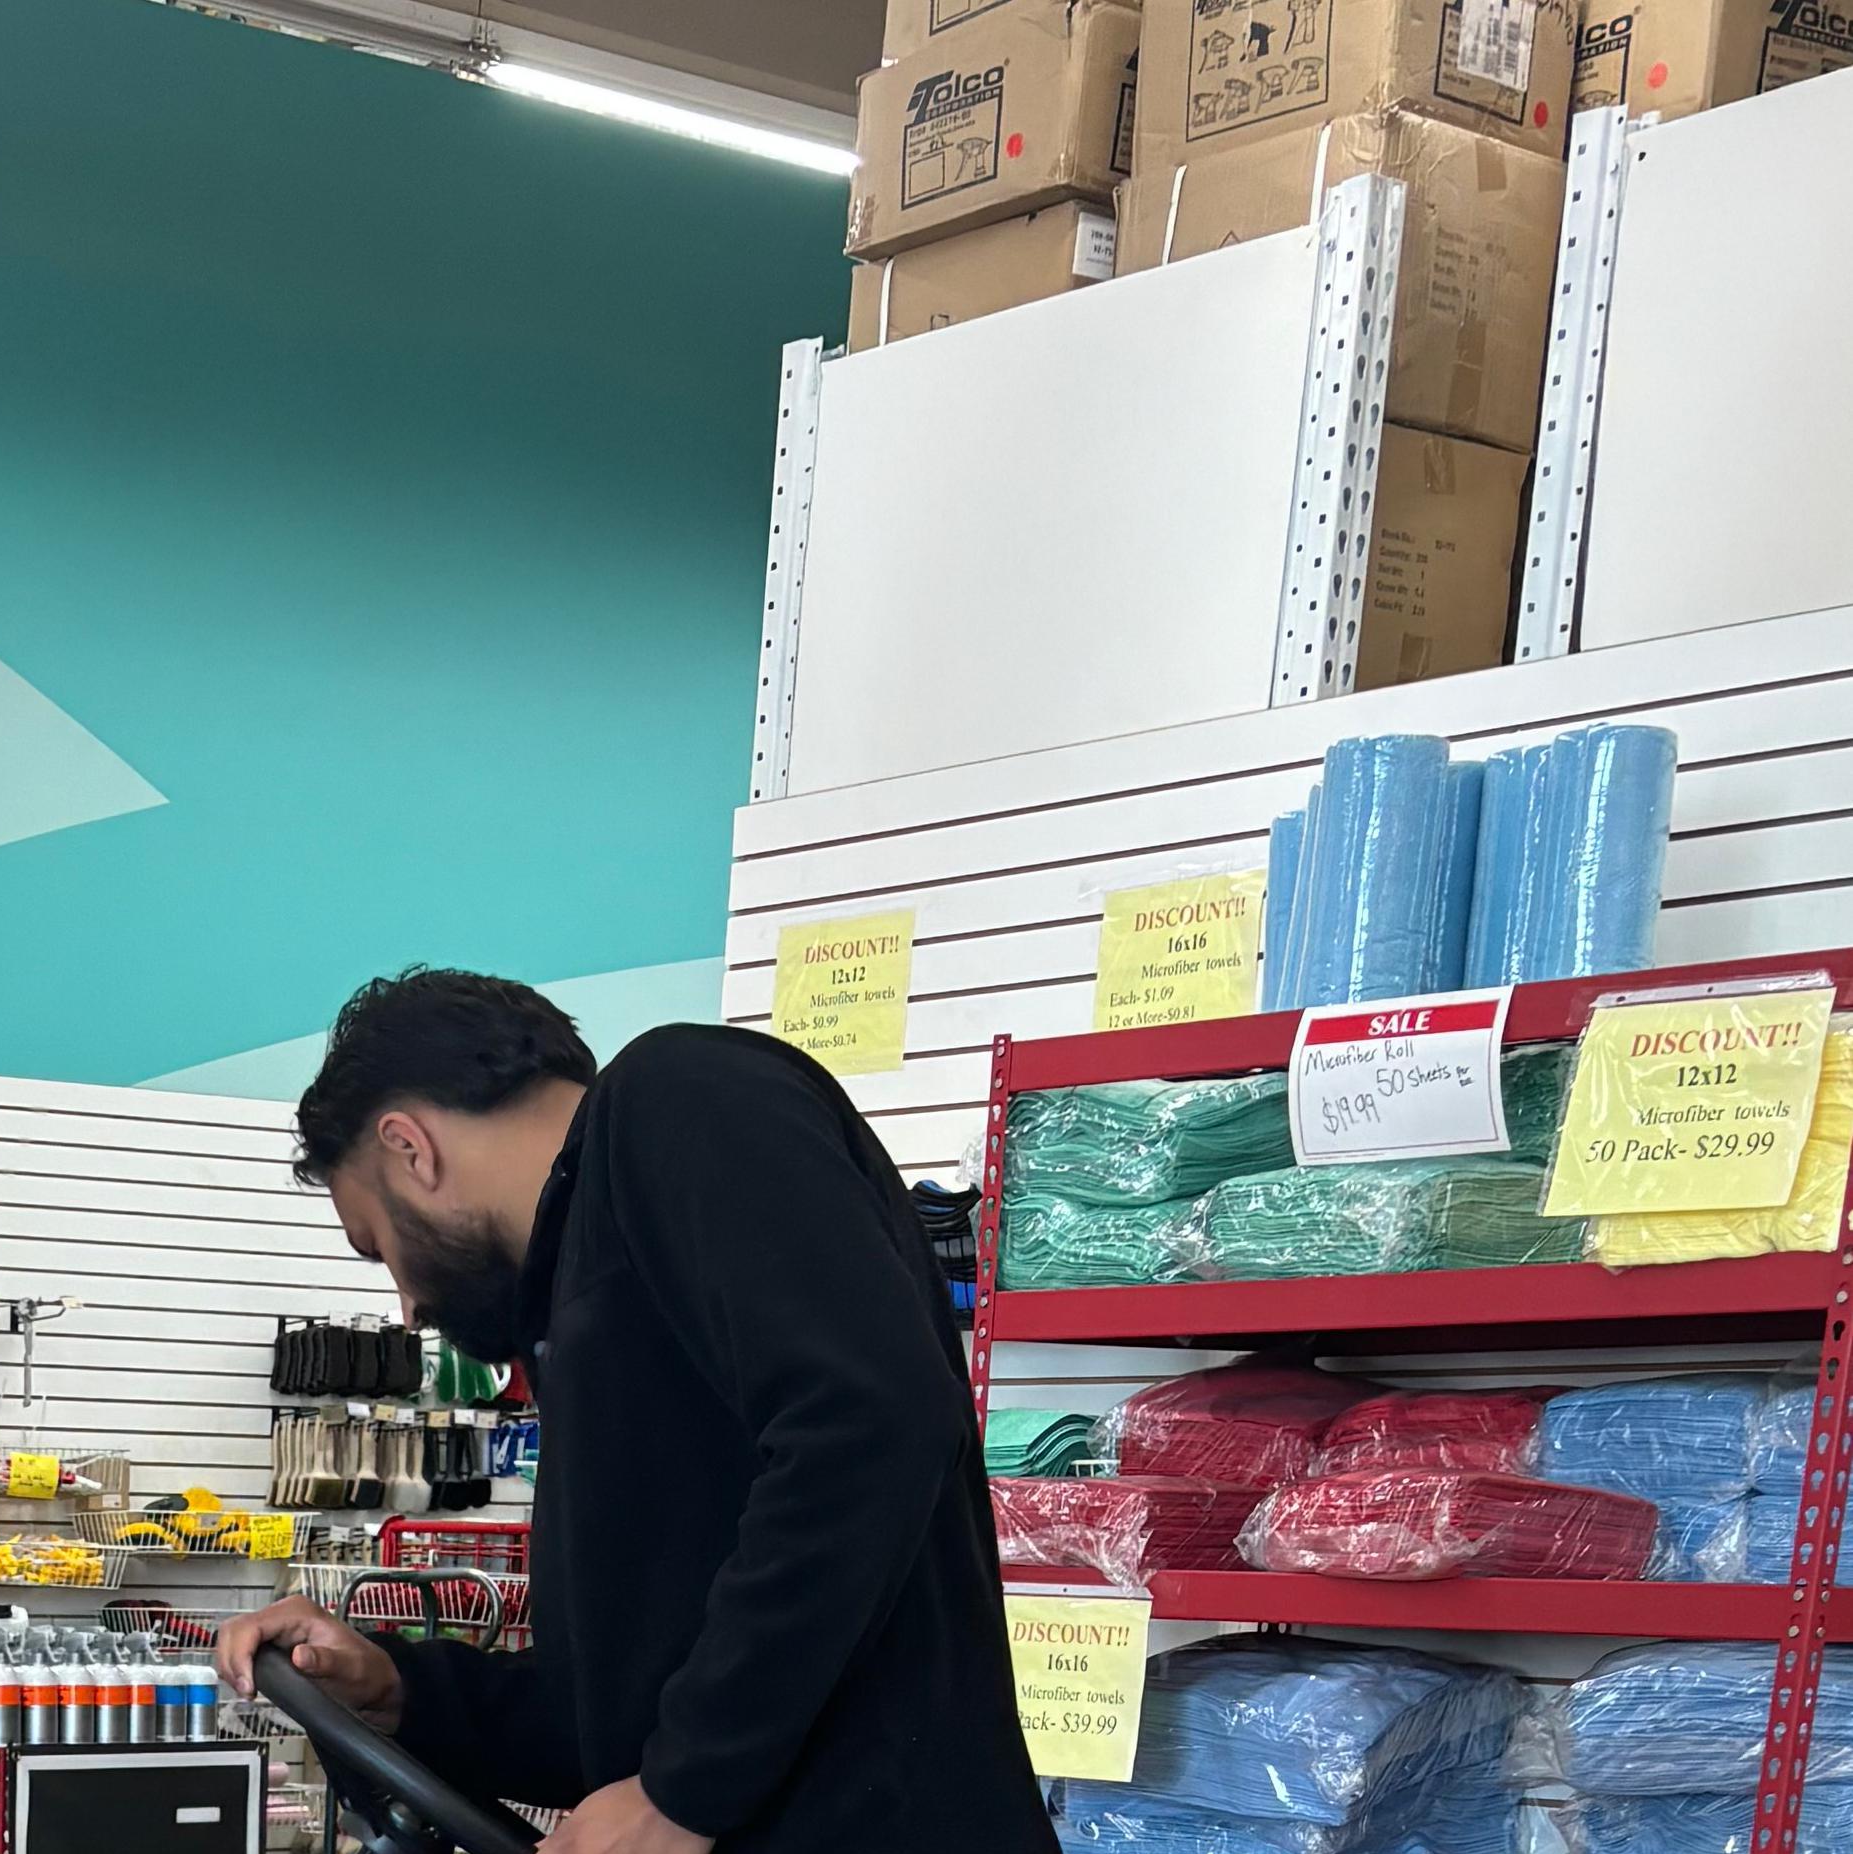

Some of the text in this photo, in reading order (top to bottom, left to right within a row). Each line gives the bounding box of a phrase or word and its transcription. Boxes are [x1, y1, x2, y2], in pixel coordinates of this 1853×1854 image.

[1575, 14, 1633, 50] lco
[906, 65, 1005, 124] Tolco
[1134, 897, 1246, 932] DISCOUNT!!
[805, 935, 899, 964] DISCOUNT!!
[1167, 932, 1208, 954] 16x16
[832, 966, 866, 985] 12x12
[1141, 952, 1242, 979] Microfiber towels
[810, 986, 895, 1008] Microfiber towels
[1110, 986, 1174, 1007] Each- $1.09
[783, 1015, 838, 1033] Each- $0.99
[1108, 1013, 1120, 1028] 12
[1367, 1009, 1433, 1036] SALE
[1385, 1040, 1414, 1062] Roll
[1630, 1022, 1803, 1058] DISCOUNT!!
[1376, 1068, 1405, 1097] 50
[1676, 1063, 1738, 1087] 12x12
[1637, 1100, 1791, 1126] Microfiber towels
[1585, 1131, 1776, 1163] 50 Pack- $29.99
[1013, 1622, 1131, 1647] DISCOUNT!!
[1047, 1653, 1089, 1672] 16x16
[1020, 1684, 1126, 1705] Microfiber towels
[1060, 1712, 1118, 1736] $39.99
